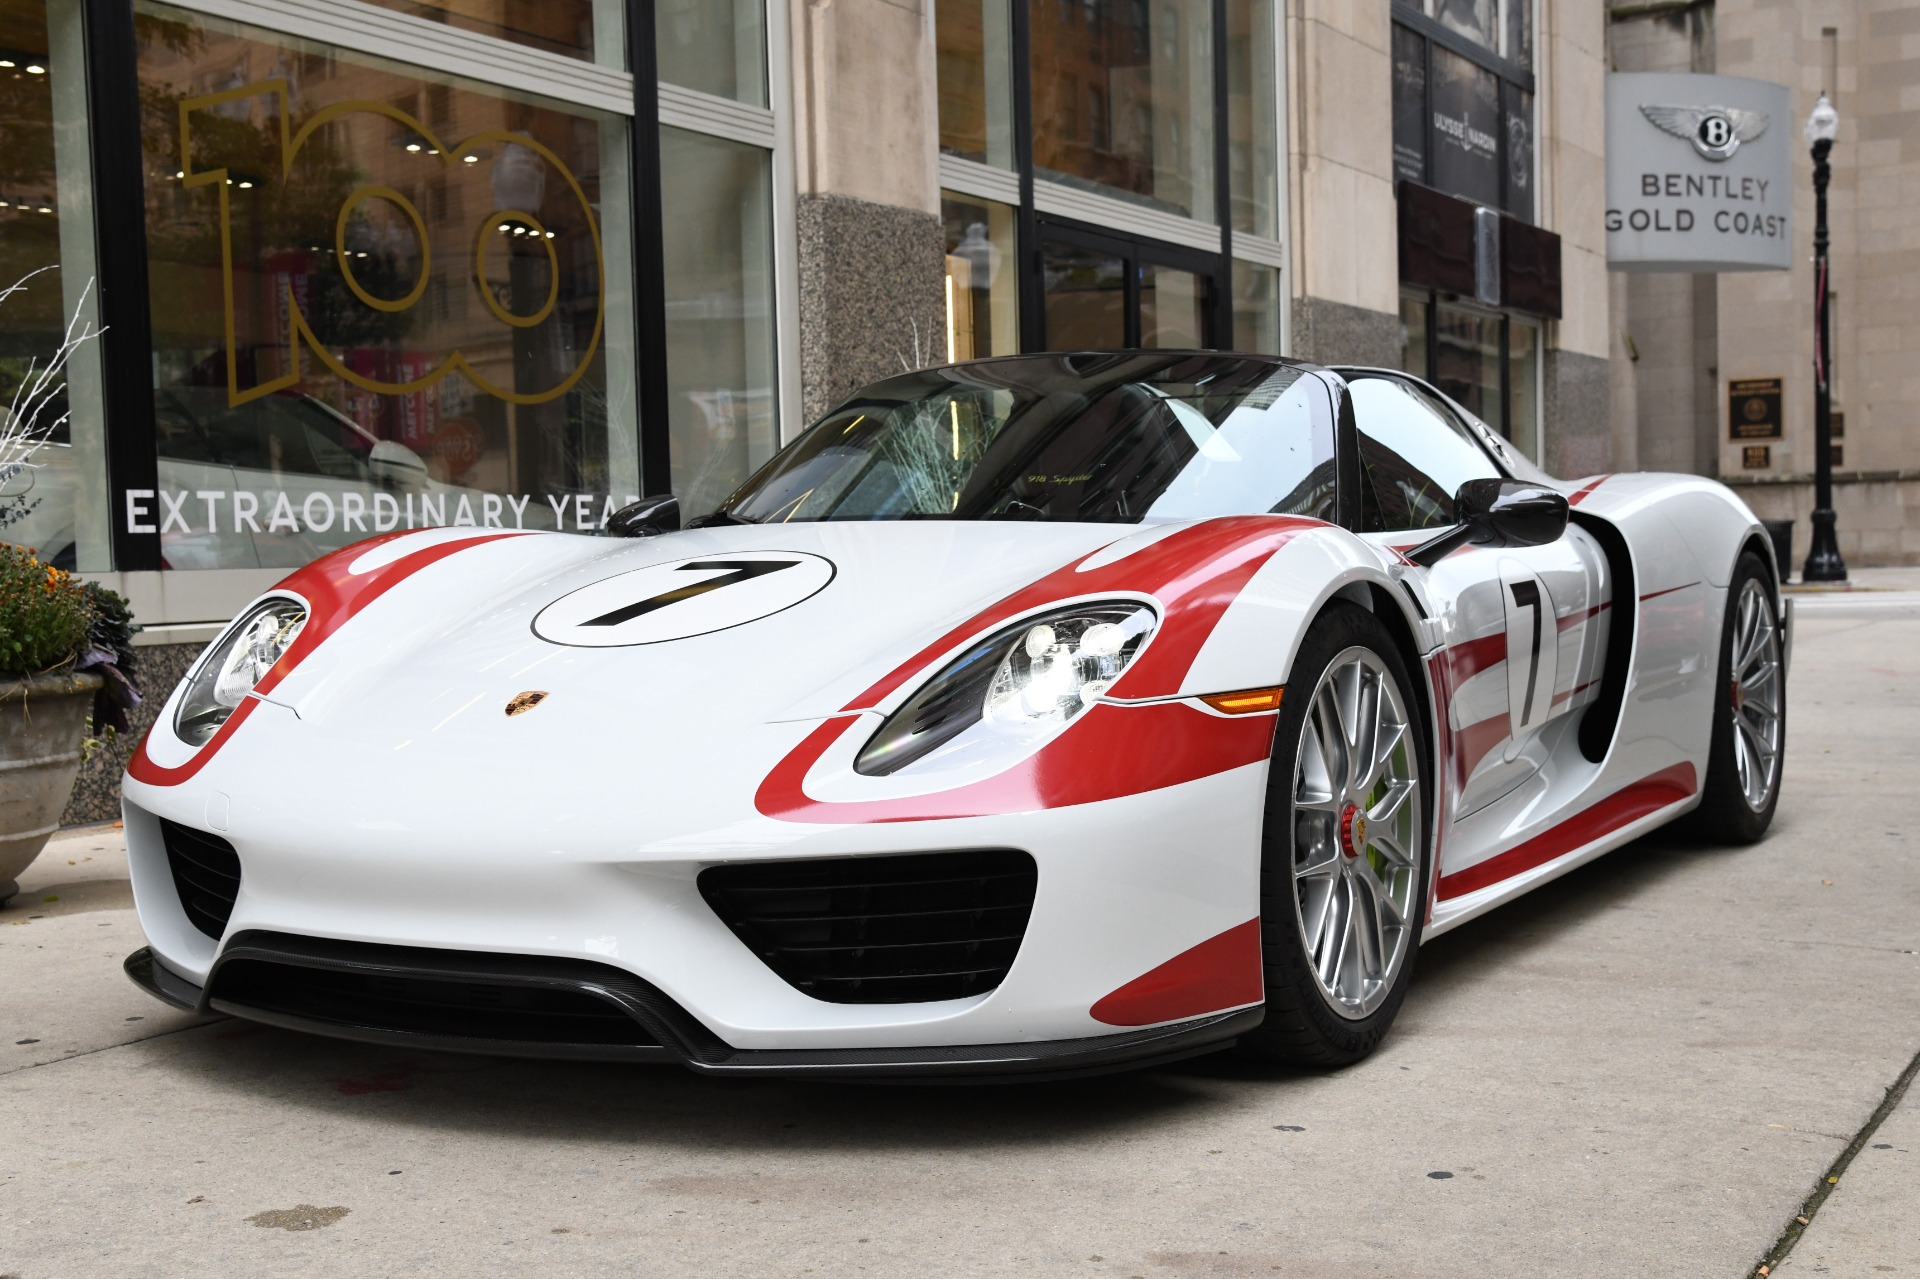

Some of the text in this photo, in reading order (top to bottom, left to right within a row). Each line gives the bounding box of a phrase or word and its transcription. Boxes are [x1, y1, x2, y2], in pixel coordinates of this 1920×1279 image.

[1433, 112, 1496, 153] ULYSSE NARDIN
[1641, 174, 1770, 201] BENTLEY
[179, 78, 605, 409] 100
[1605, 209, 1787, 239] GOLD COAST
[1027, 473, 1094, 486] 918 Spyder
[126, 489, 531, 534] EXTRAORDINARY
[575, 560, 804, 627] 7
[1509, 580, 1541, 728] 7
